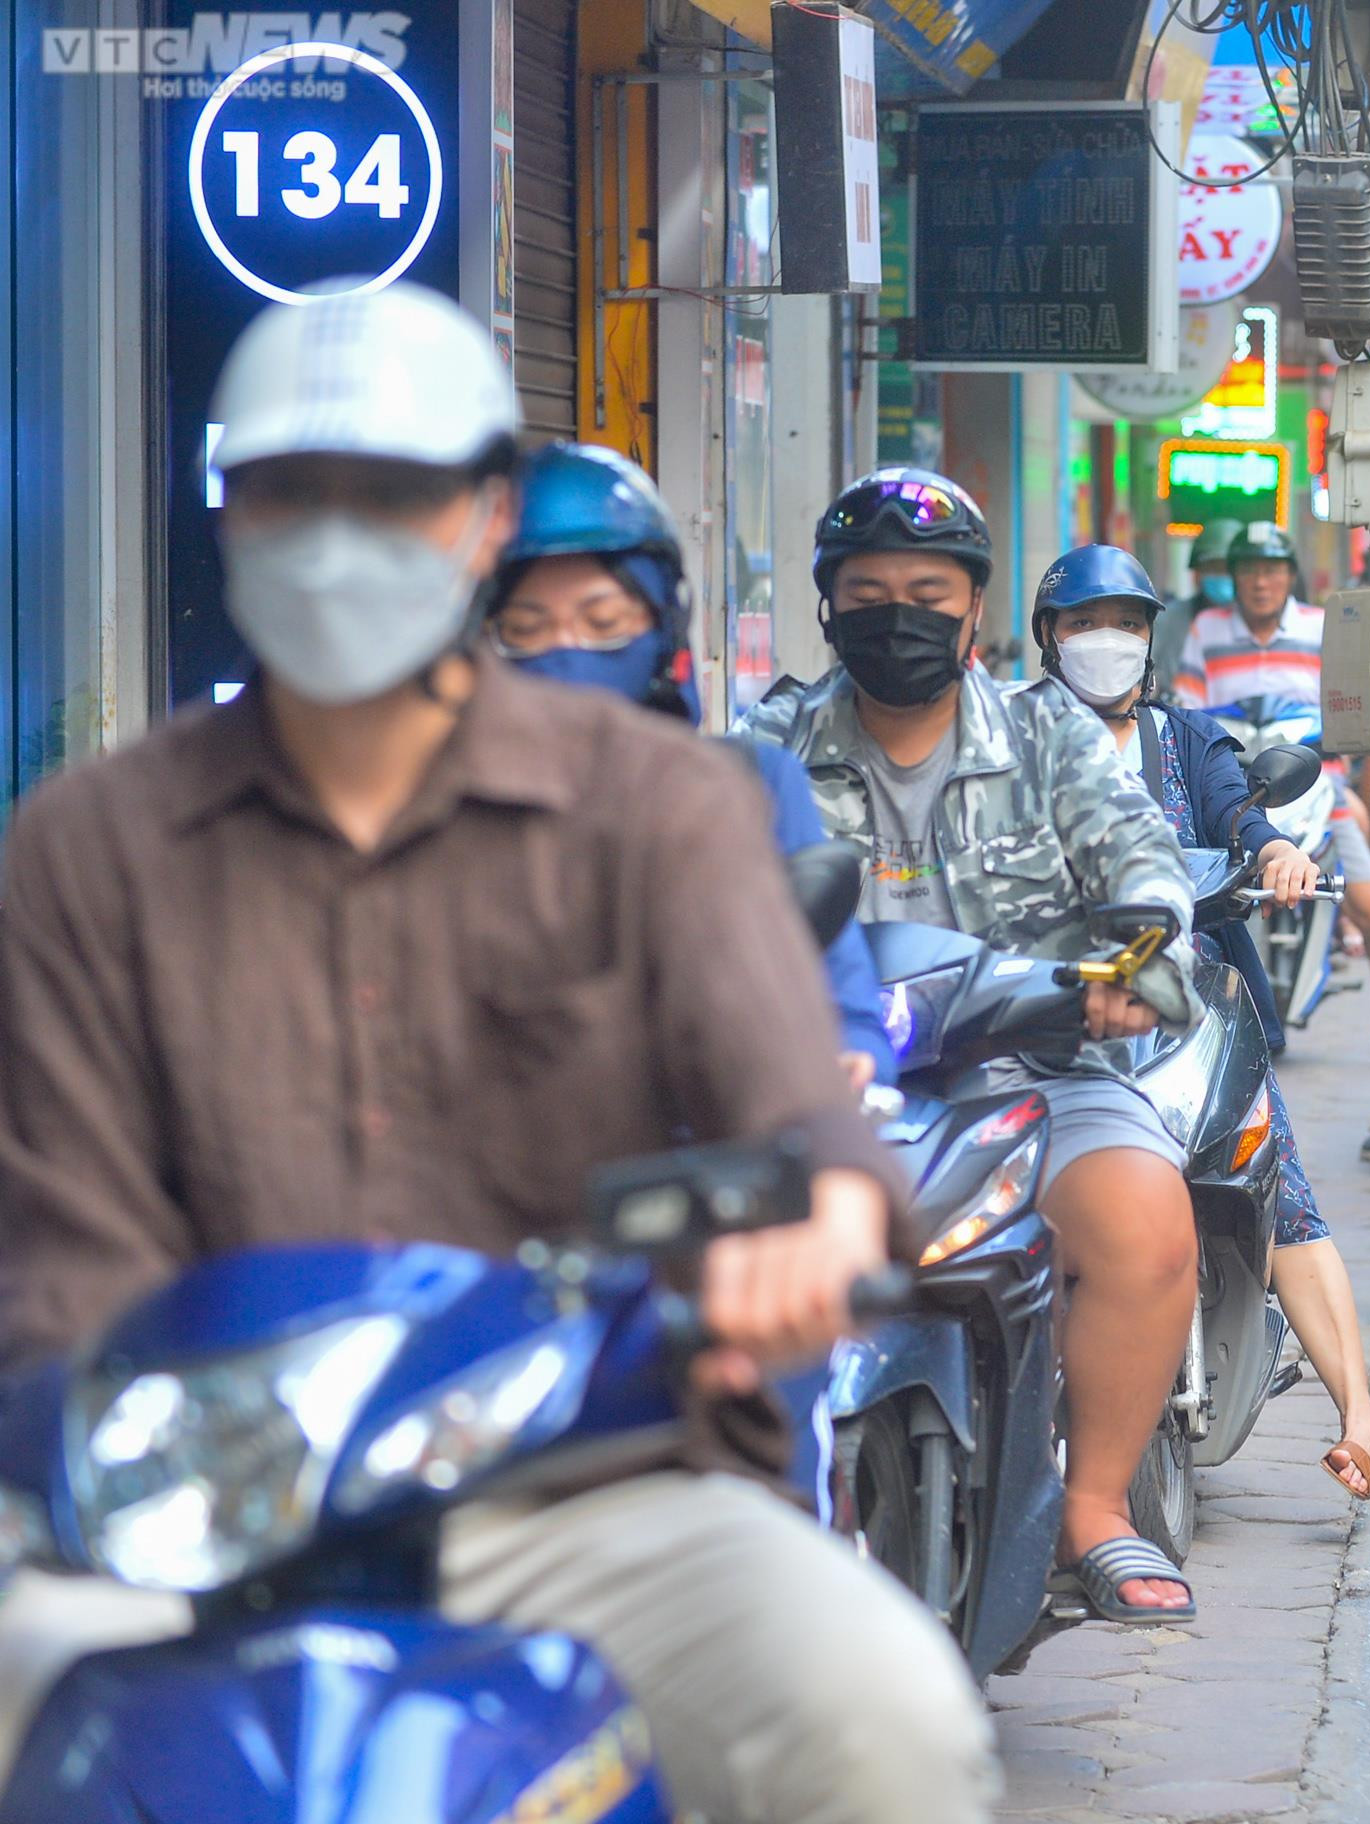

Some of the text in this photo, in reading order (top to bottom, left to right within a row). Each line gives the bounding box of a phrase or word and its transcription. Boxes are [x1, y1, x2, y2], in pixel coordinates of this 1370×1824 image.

[222, 130, 410, 219] 134
[1036, 166, 1135, 224] TÍNH
[955, 233, 1048, 293] MÁY
[1061, 244, 1108, 292] IN
[944, 302, 1122, 351] CAMERA
[1328, 697, 1362, 712] 19001515
